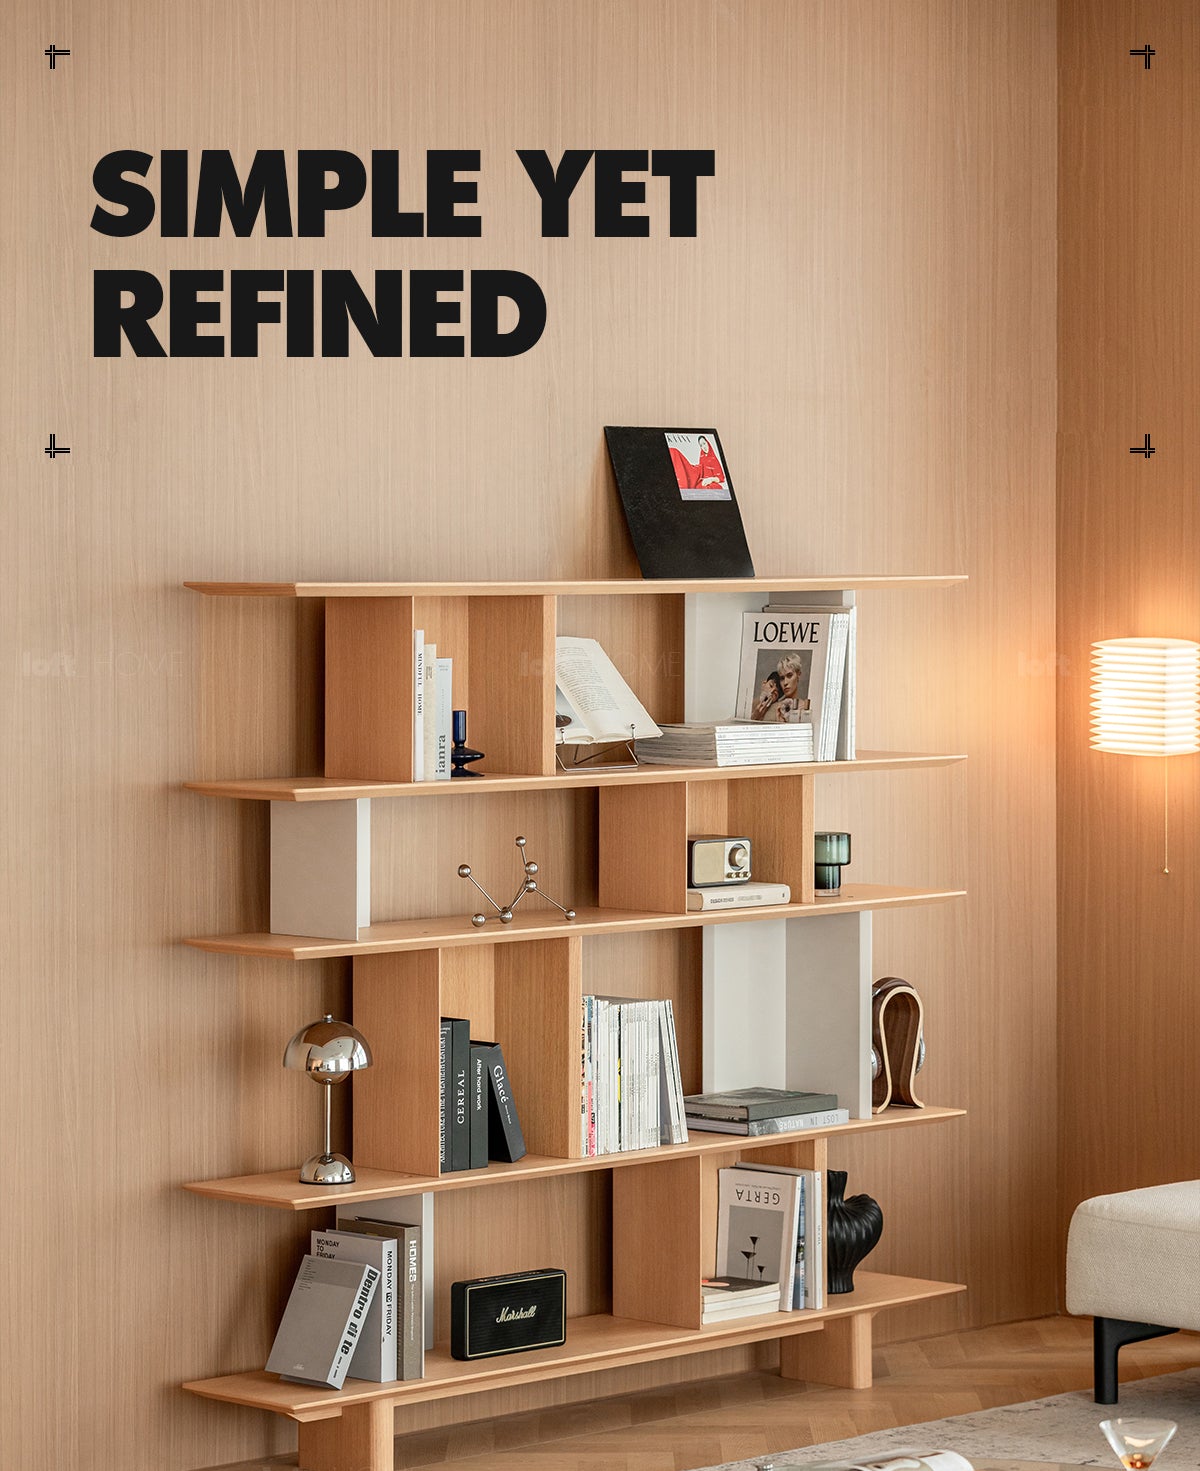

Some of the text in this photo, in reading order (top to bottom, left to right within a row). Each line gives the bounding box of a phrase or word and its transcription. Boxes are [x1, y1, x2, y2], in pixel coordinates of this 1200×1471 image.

[753, 621, 819, 643] LOEWE
[493, 1065, 509, 1104] Glacé
[457, 1069, 465, 1125] CEREAL
[810, 1116, 818, 1125] IN
[823, 1114, 839, 1124] LOST
[735, 1188, 780, 1205] GERTA
[316, 1238, 340, 1248] MONDAY
[409, 1240, 417, 1283] HOMES
[340, 1268, 378, 1355] Dentro di te
[495, 1305, 537, 1323] Marshall
